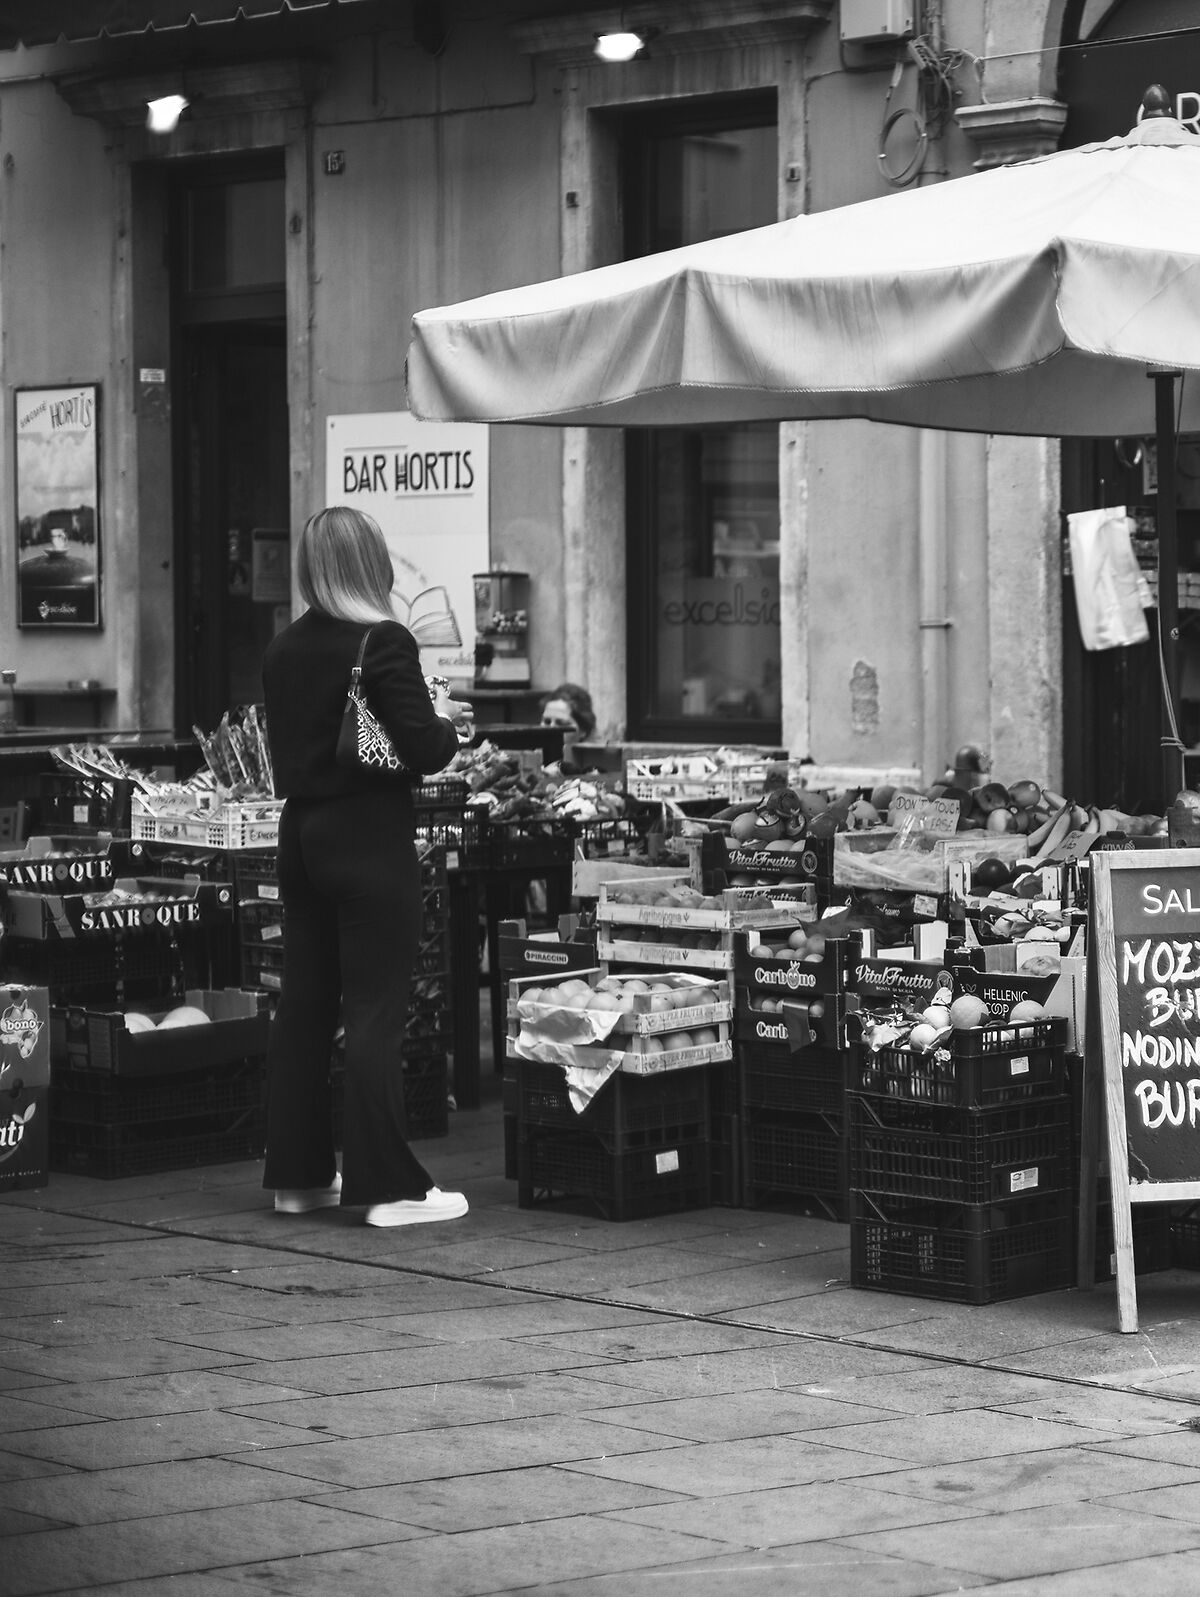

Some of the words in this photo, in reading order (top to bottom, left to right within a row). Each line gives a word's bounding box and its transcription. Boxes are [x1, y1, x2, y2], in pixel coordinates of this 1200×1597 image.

[343, 455, 387, 493] BAR
[394, 451, 474, 491] HORTIS
[529, 952, 568, 963] PIRACCINI
[983, 988, 1028, 1002] HELLENIC
[5, 1018, 37, 1031] bono
